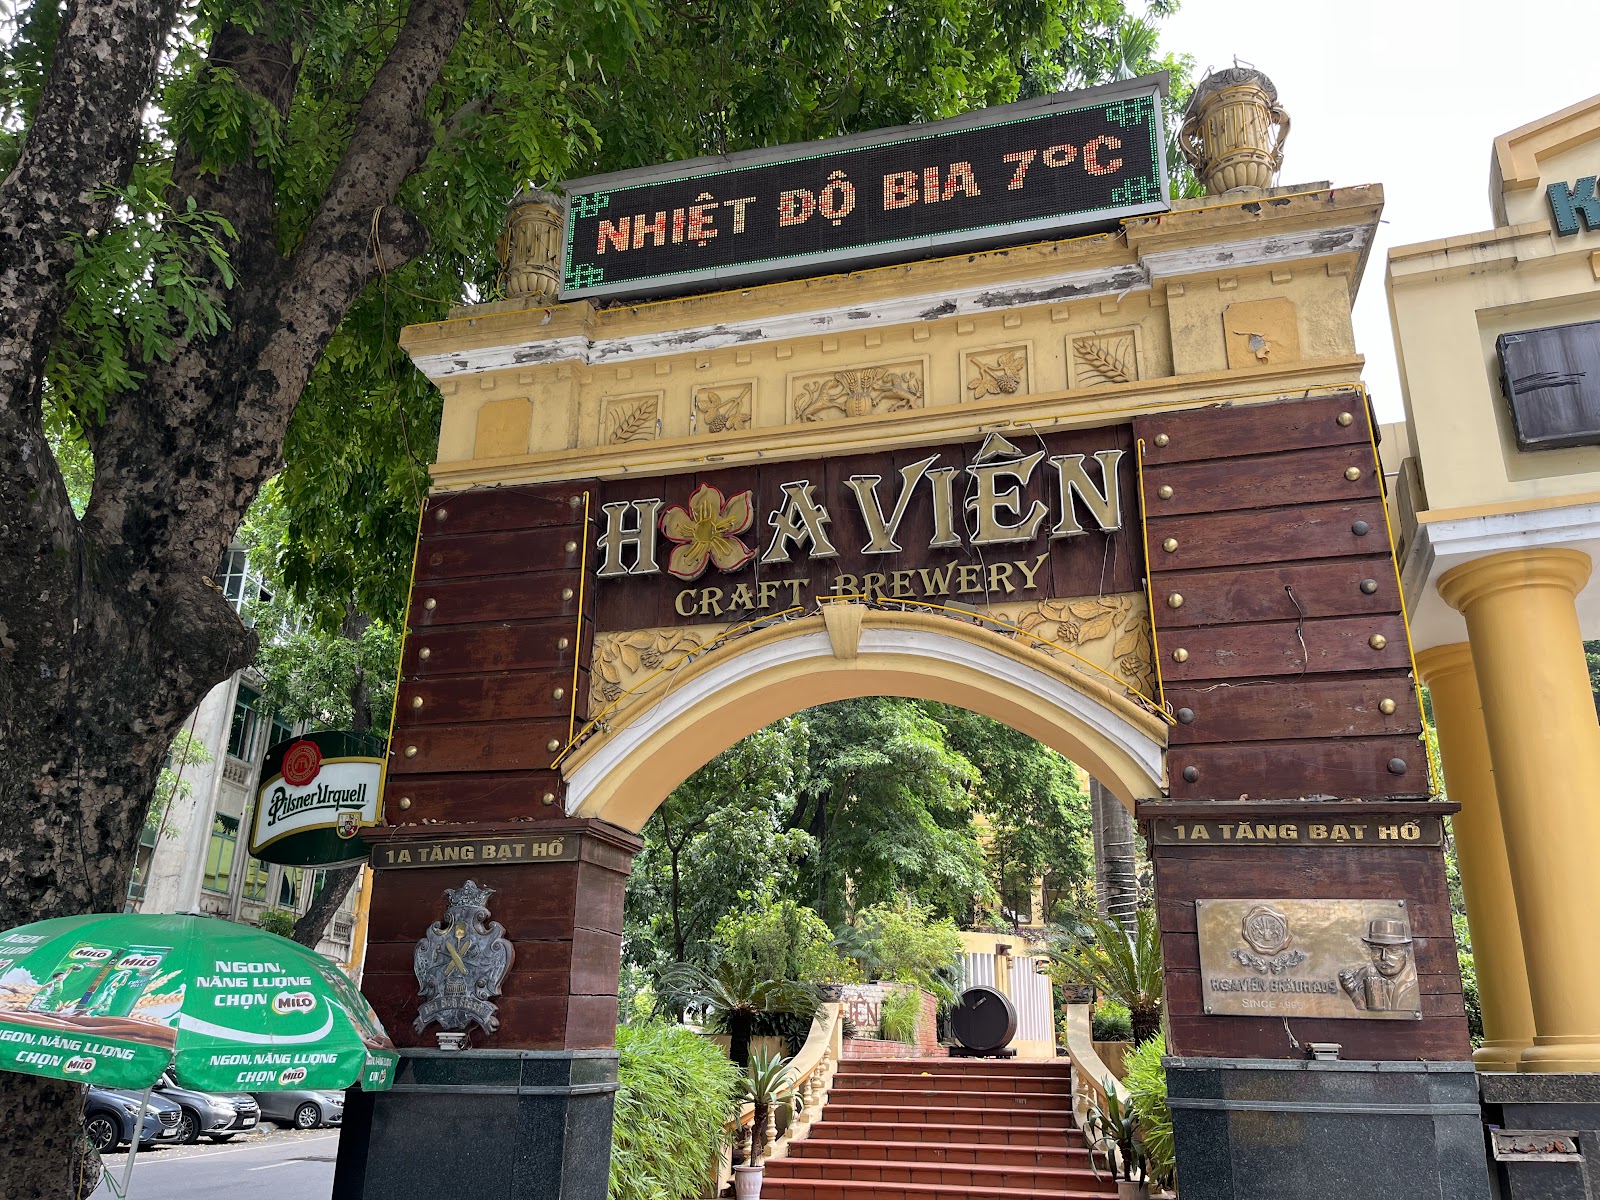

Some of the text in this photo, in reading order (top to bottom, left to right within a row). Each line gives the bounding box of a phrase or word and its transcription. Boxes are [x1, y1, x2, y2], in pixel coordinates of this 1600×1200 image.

[596, 193, 757, 255] NHIỆT
[778, 169, 856, 228] ĐỘ
[883, 160, 981, 211] BIA
[675, 553, 1050, 617] CRAFT BREWERY
[267, 783, 367, 826] Pilsner Urquell
[1173, 824, 1210, 840] 1A
[1218, 822, 1298, 840] TĂNG
[1308, 824, 1368, 843] BẠT
[386, 849, 412, 864] 1A
[418, 844, 475, 862] TĂNG
[481, 843, 526, 861] BẠT
[120, 958, 158, 967] MILO
[215, 960, 286, 975] NGON,
[196, 975, 248, 988] NĂNG
[214, 993, 313, 1009] CHỌN MILO
[1242, 998, 1276, 1009] SINCE
[15, 1050, 93, 1070] CHỌN MILO
[236, 1070, 304, 1085] CHỌN MILO
